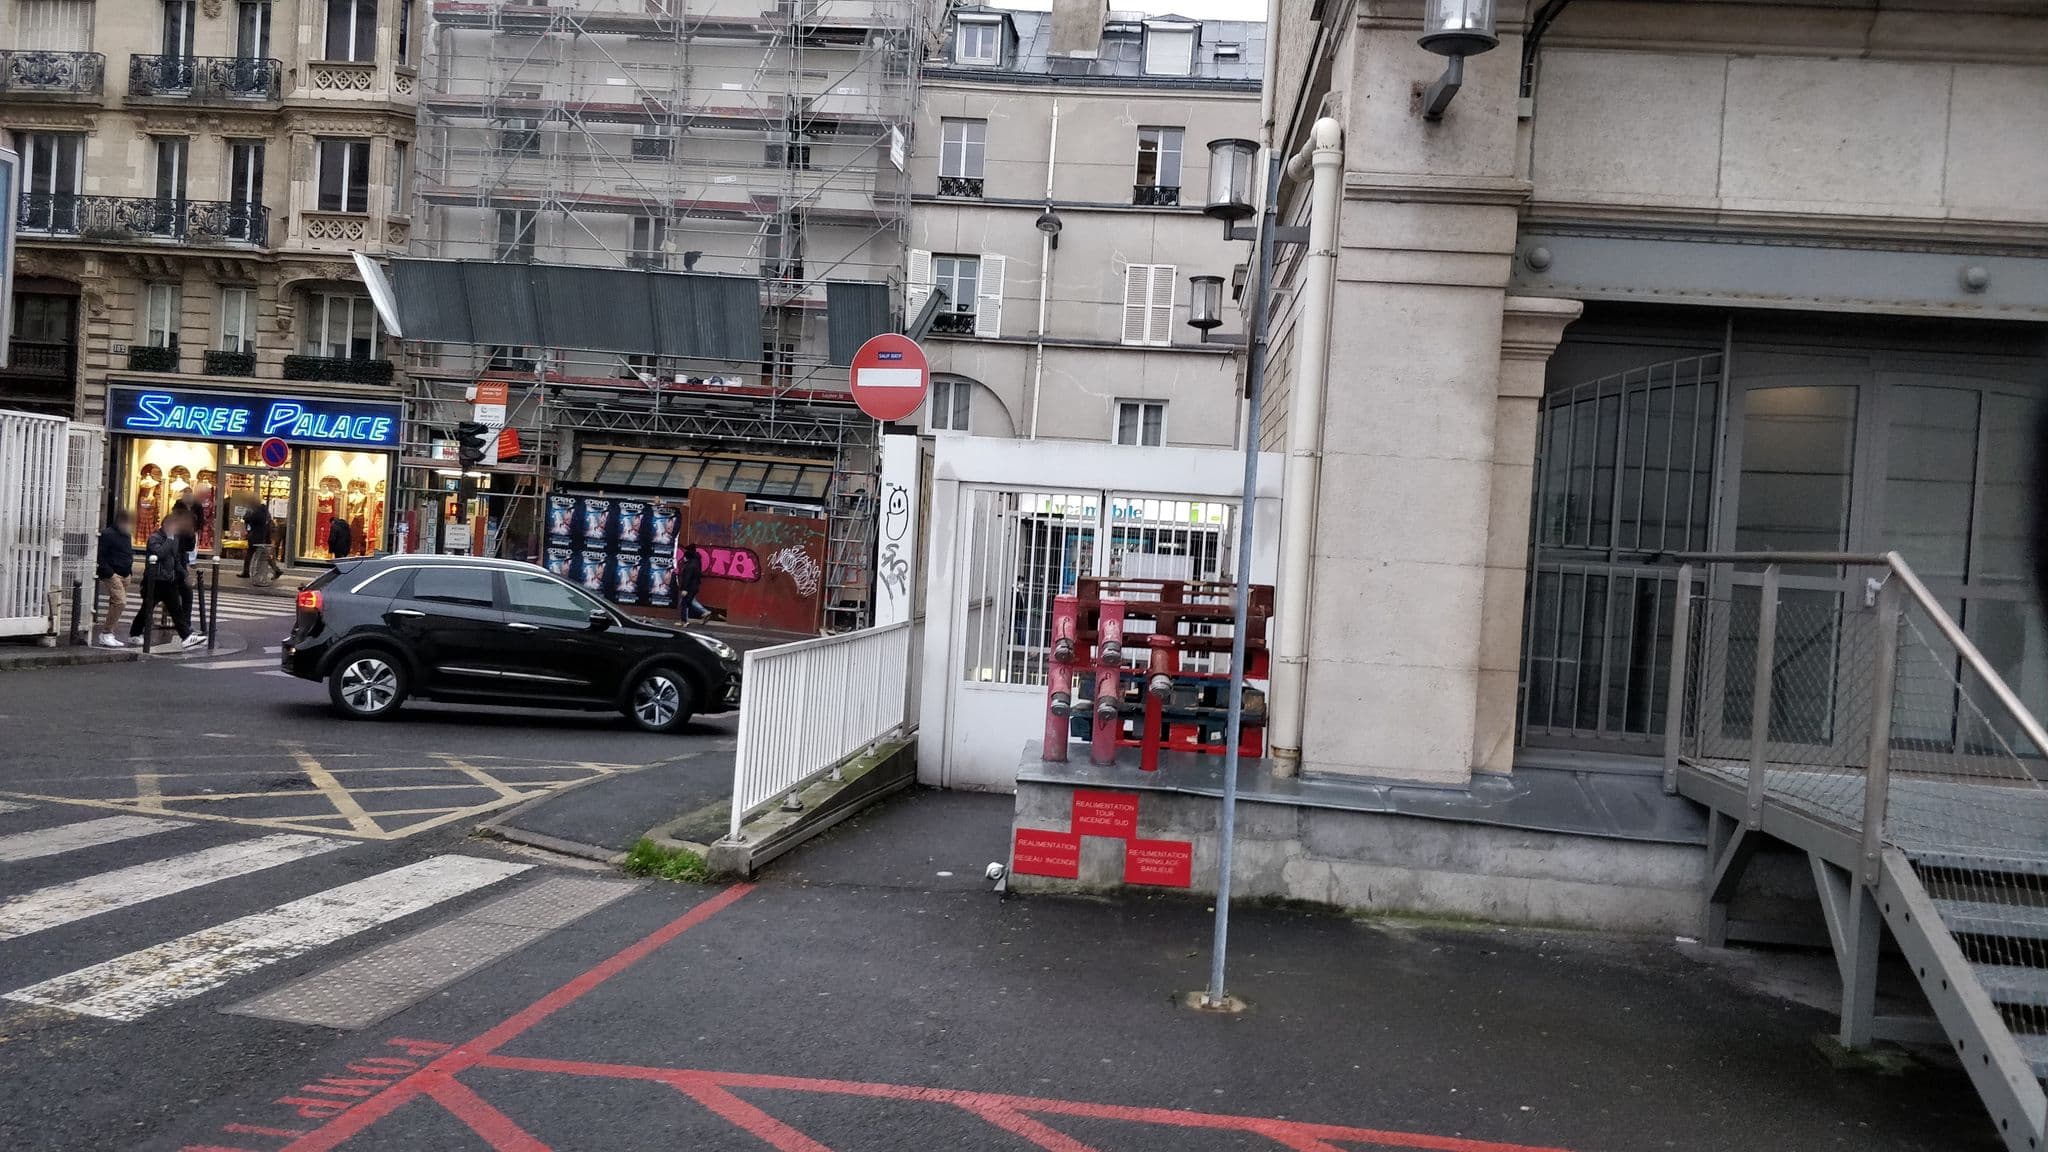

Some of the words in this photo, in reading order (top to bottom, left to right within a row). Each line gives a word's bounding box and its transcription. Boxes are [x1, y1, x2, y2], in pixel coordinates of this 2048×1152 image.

[127, 394, 249, 436] SAREE
[263, 402, 391, 441] PALACE
[1096, 809, 1115, 817] TOUR
[1079, 816, 1111, 825] INCENDIE
[1114, 818, 1129, 826] SUD
